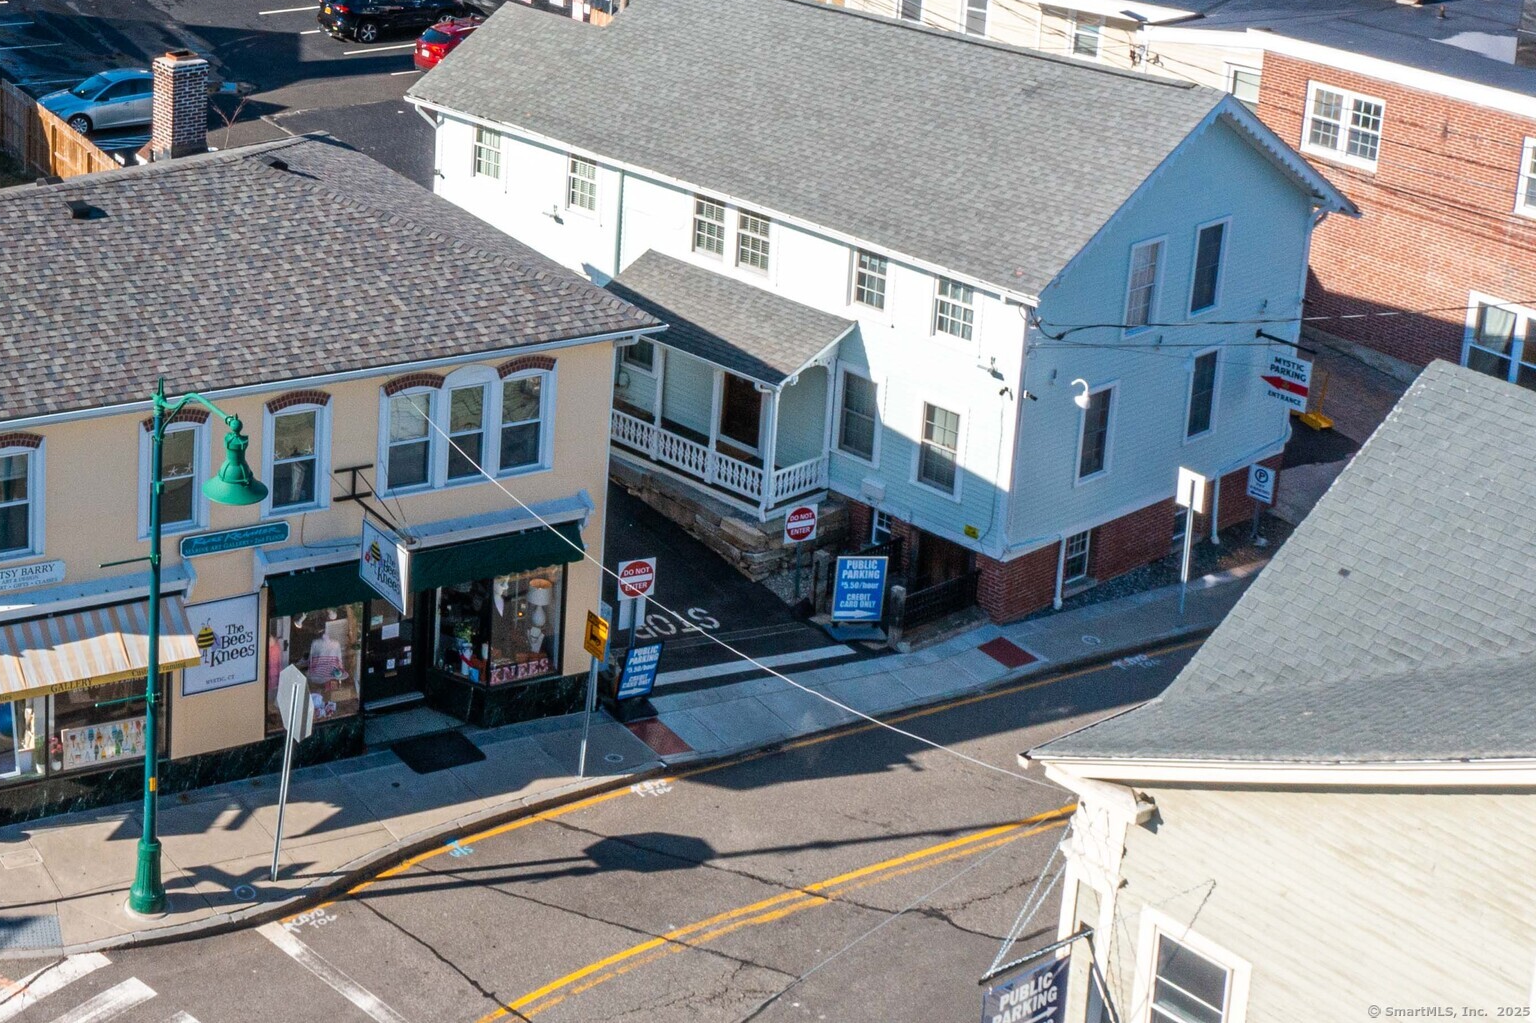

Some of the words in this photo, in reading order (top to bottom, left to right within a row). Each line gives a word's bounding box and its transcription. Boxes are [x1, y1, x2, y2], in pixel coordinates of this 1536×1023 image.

[1274, 356, 1305, 372] MYSTIC
[1269, 363, 1307, 383] PARKING
[1267, 389, 1302, 406] ENTRANCE
[789, 514, 799, 522] DO
[800, 512, 813, 520] NOT
[790, 526, 811, 536] ENTER
[21, 563, 55, 576] BARRY
[635, 566, 650, 575] NOT
[845, 559, 878, 570] PUBLIC
[841, 569, 881, 580] PARKING
[376, 567, 401, 595] Knees
[625, 581, 648, 592] ENTER
[846, 593, 871, 601] CREDIT
[839, 600, 858, 608] CARD
[859, 600, 876, 608] ONLY
[225, 623, 244, 635] The
[220, 631, 254, 650] Bee's
[209, 644, 255, 668] Knees
[633, 645, 659, 657] PUBLIC
[628, 653, 660, 665] PARKING
[490, 658, 549, 686] KNEES
[50, 678, 94, 693] GALLERY
[999, 972, 1053, 1012] PUBLIC
[992, 985, 1058, 1023] PARKING
